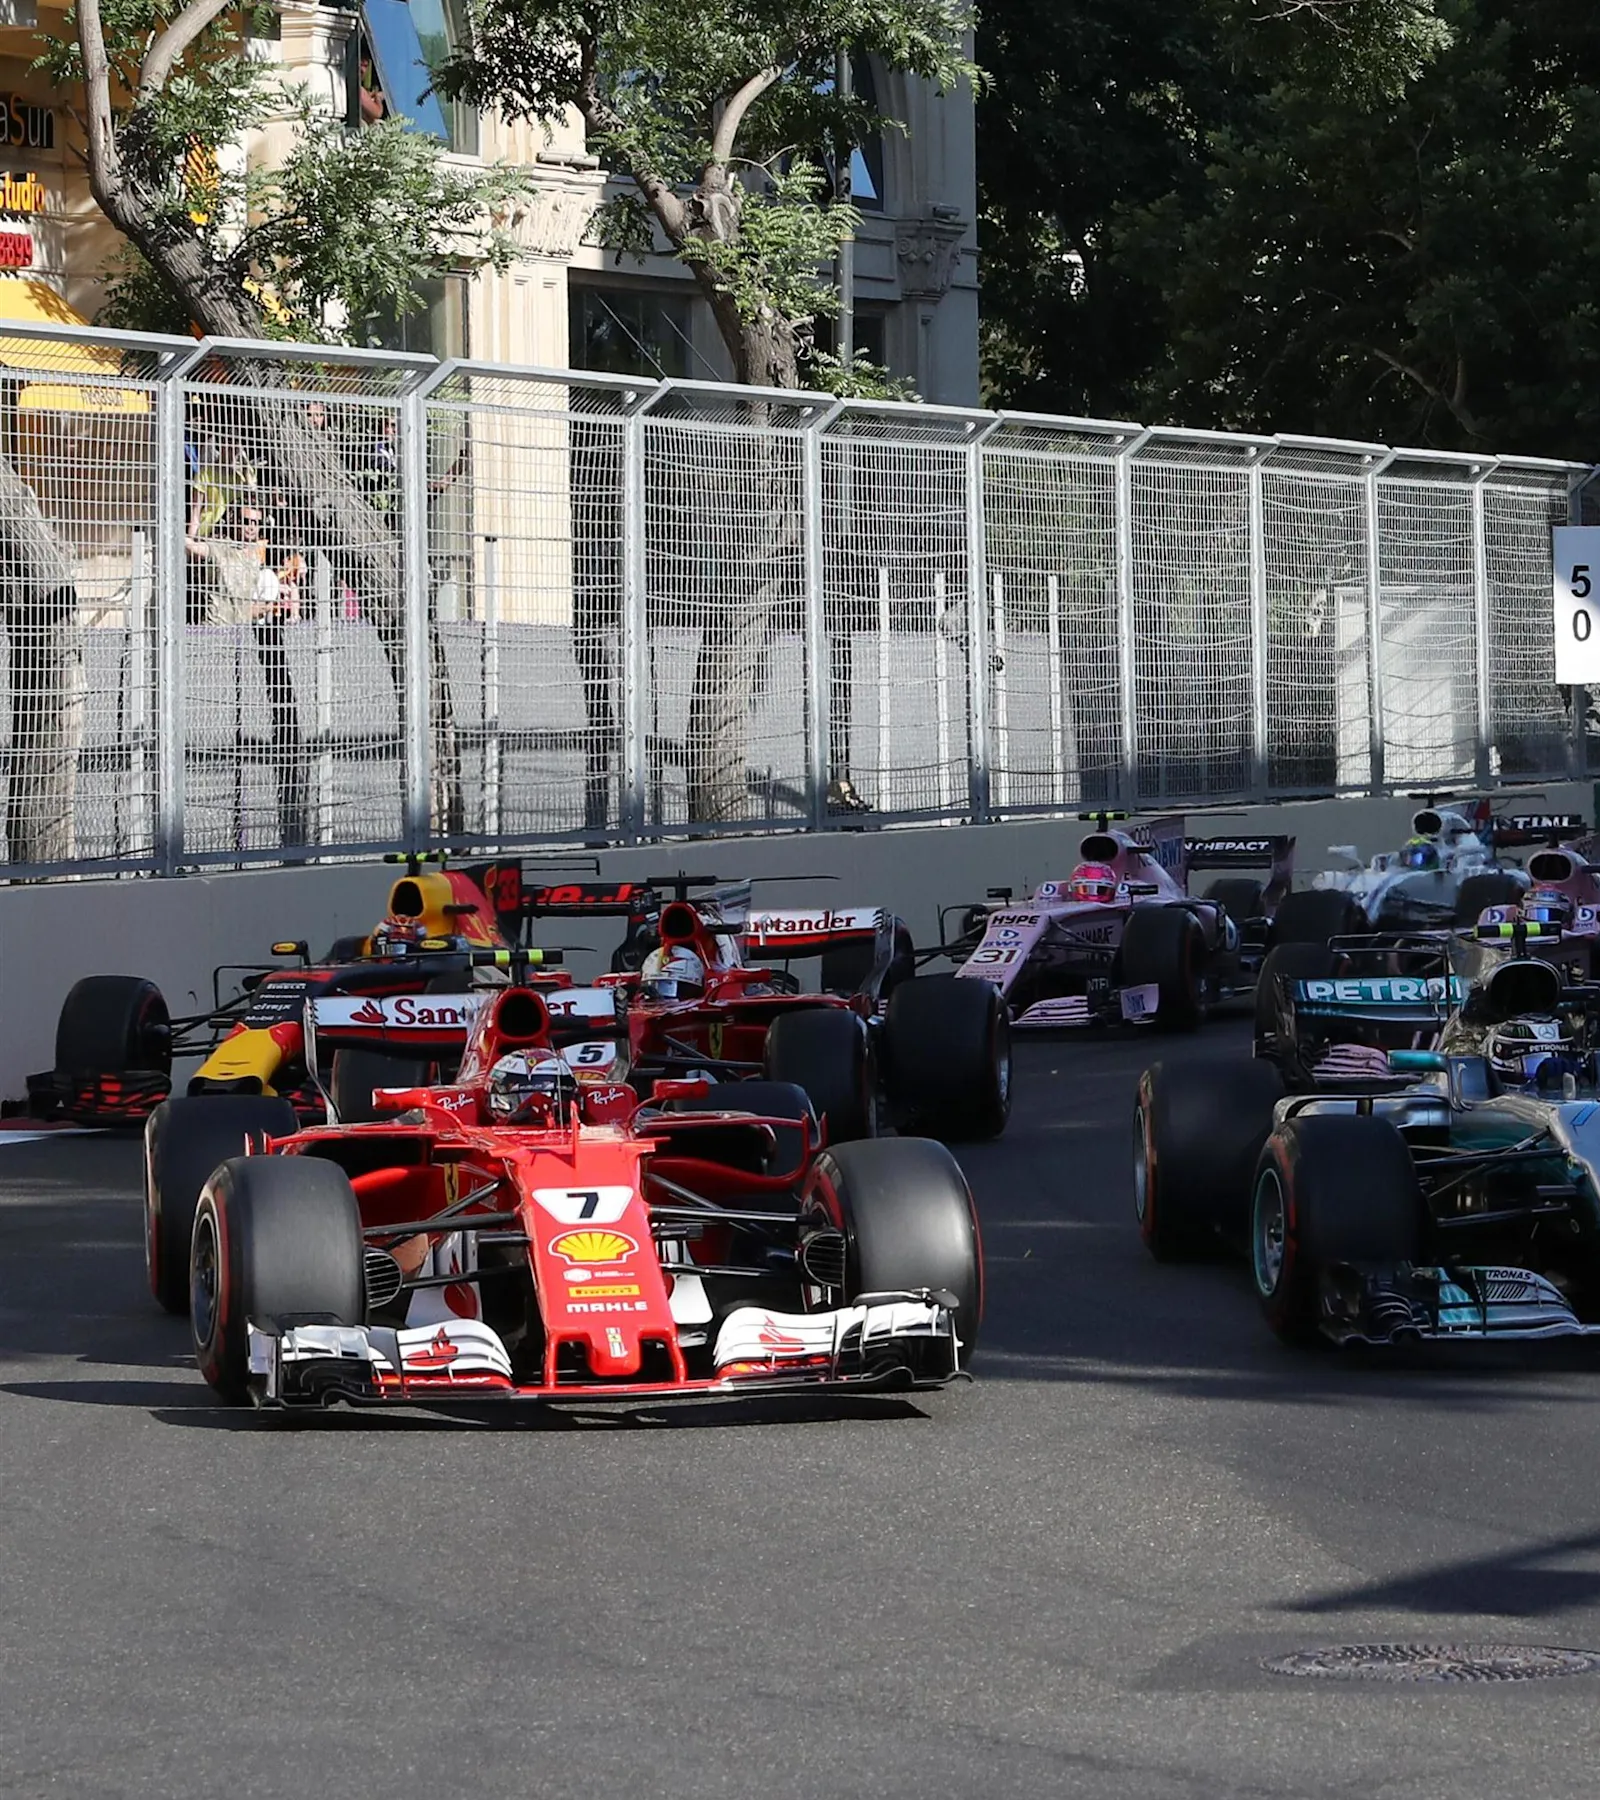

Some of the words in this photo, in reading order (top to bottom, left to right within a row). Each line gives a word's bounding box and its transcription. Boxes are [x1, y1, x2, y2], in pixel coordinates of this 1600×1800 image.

[0, 93, 55, 147] aSun
[1570, 564, 1592, 642] 50
[991, 915, 1040, 925] HYPE
[973, 949, 1016, 964] 31
[577, 1045, 606, 1064] 5
[566, 1191, 600, 1219] 7
[1488, 1269, 1532, 1281] TRONAS
[566, 1301, 649, 1314] MAHLE
